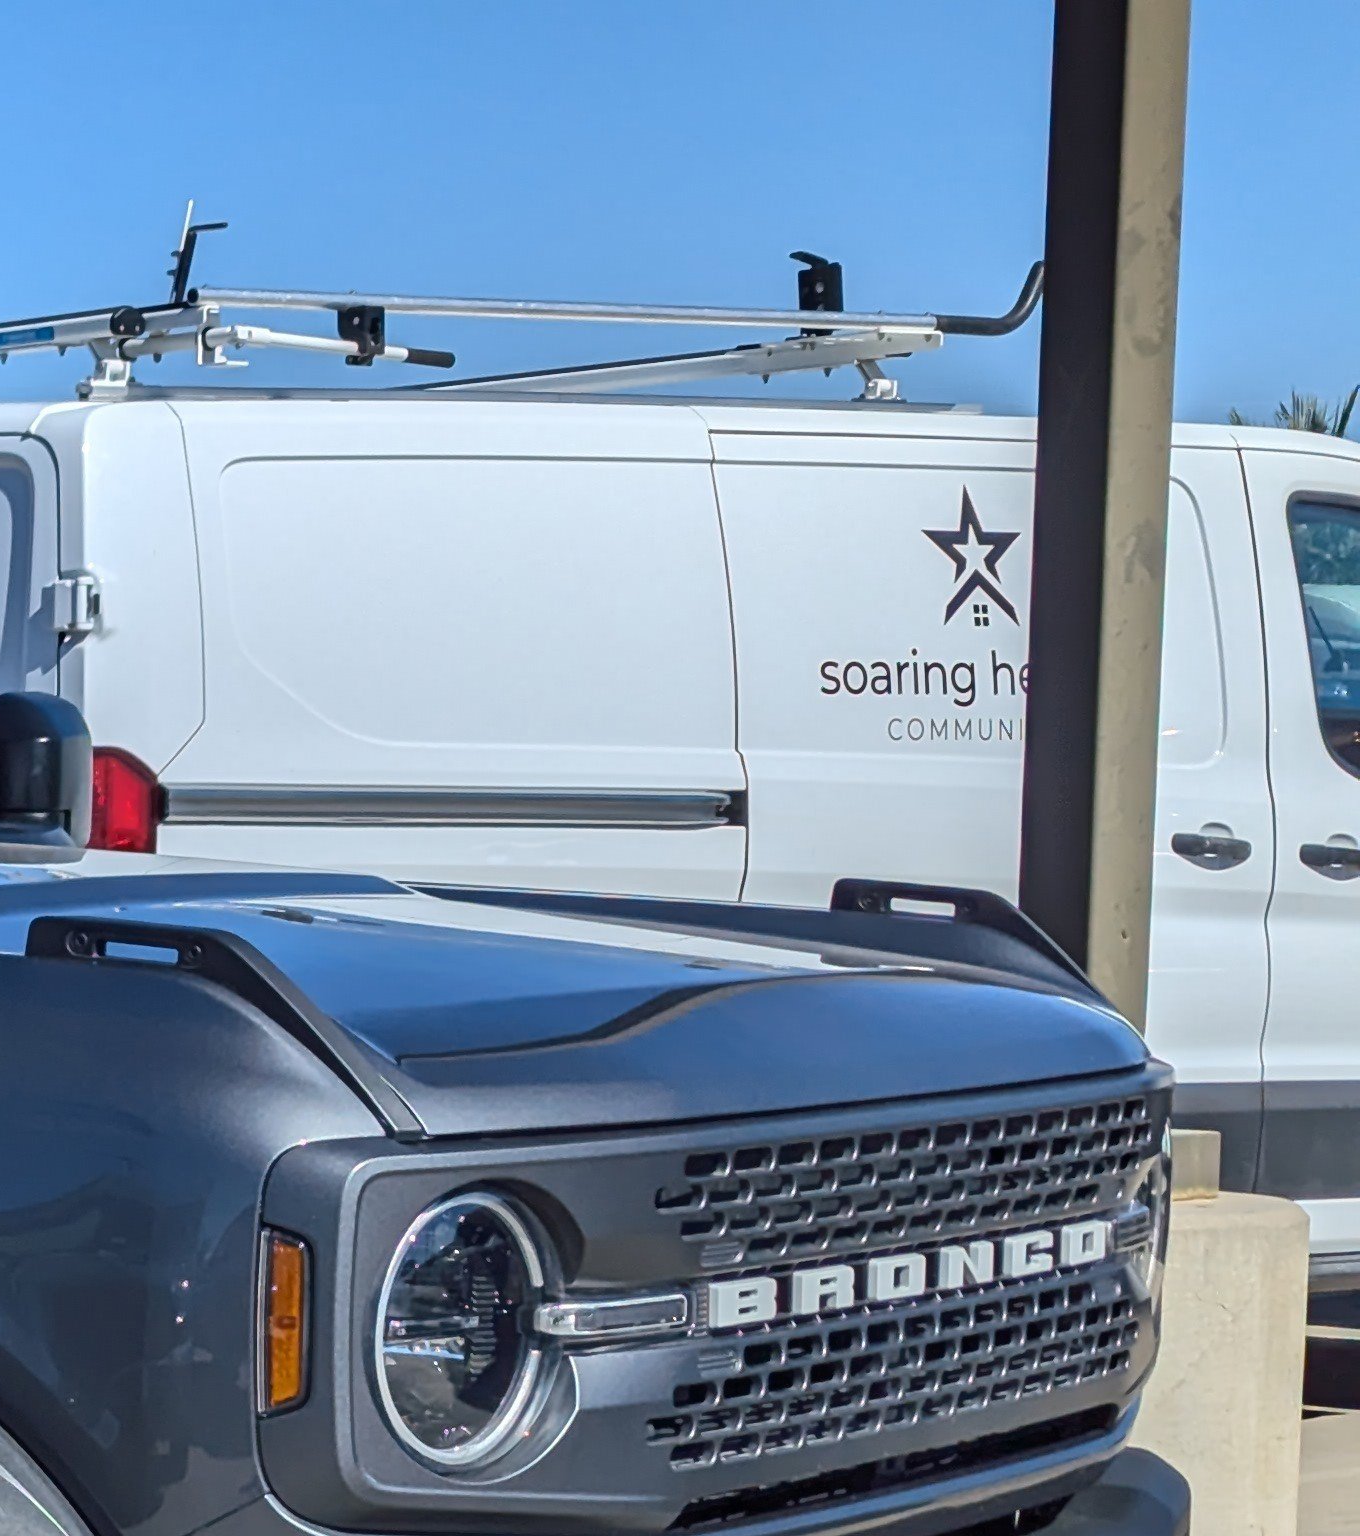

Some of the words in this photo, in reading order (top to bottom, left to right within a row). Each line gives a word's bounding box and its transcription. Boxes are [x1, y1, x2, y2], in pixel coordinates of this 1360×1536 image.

[820, 648, 977, 708] soaring
[887, 717, 1024, 741] COMMUNI
[708, 1219, 1113, 1329] BRONCO
